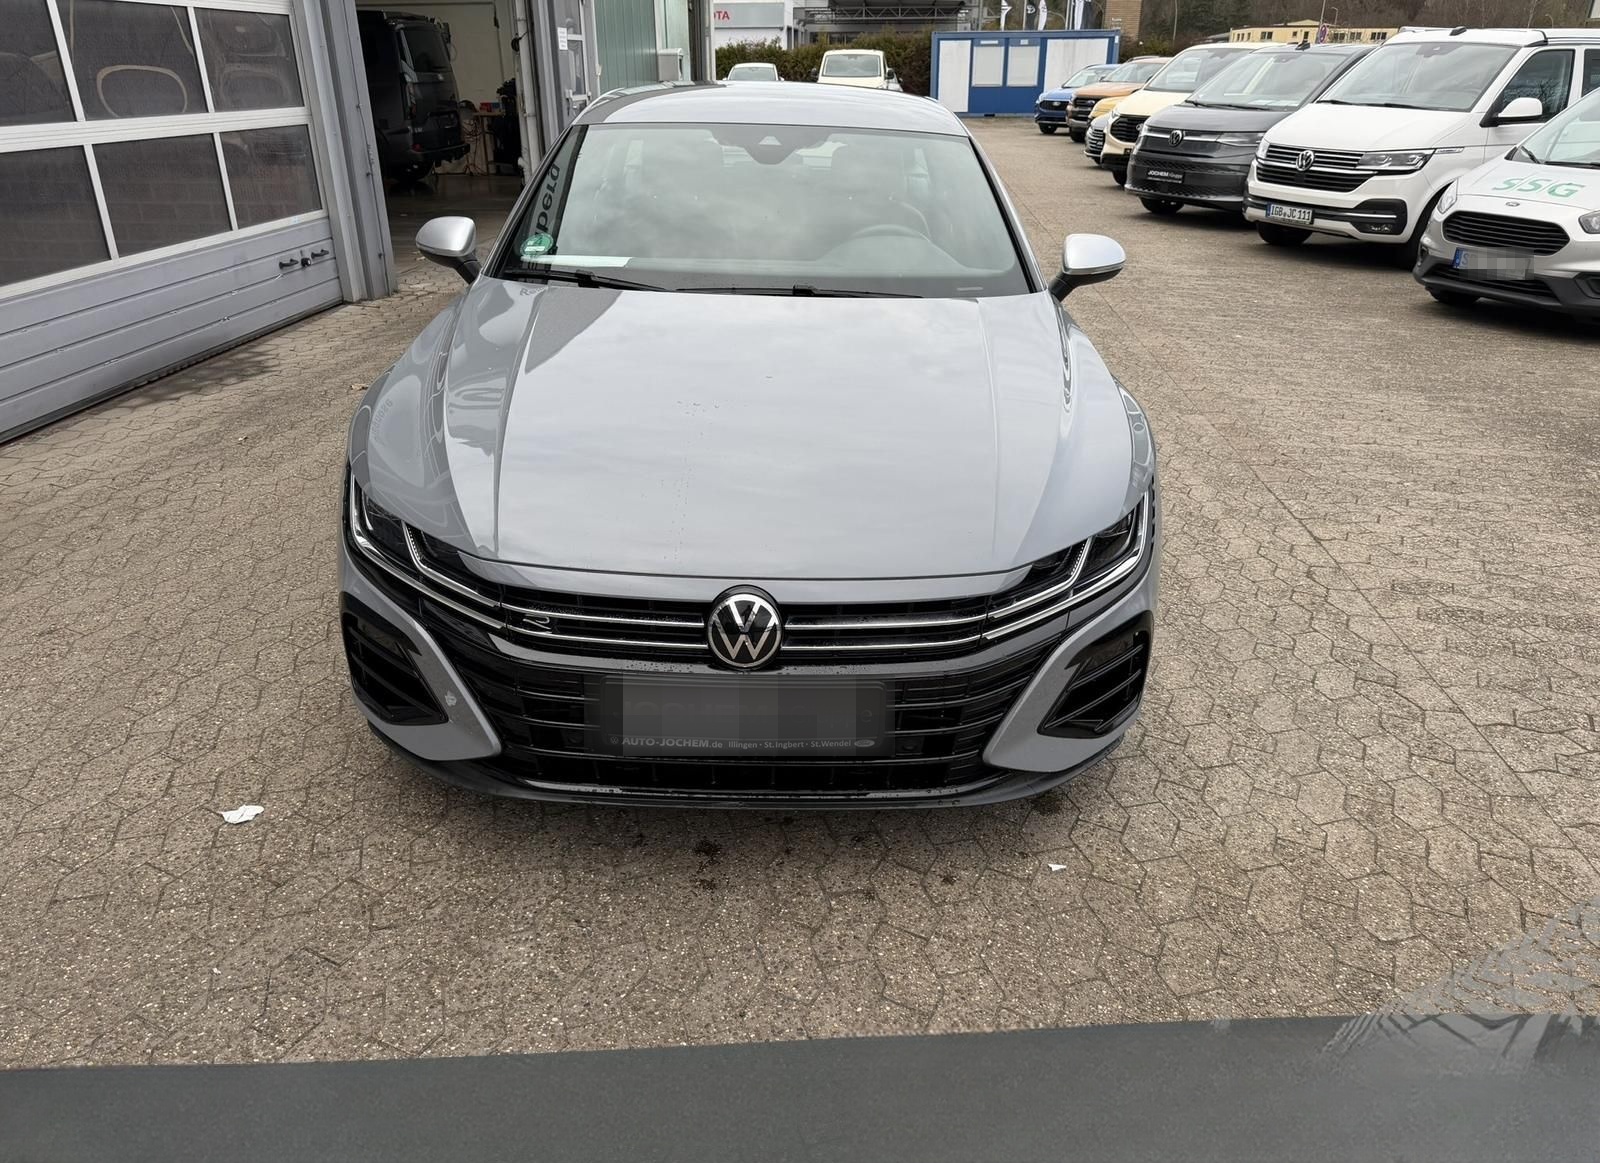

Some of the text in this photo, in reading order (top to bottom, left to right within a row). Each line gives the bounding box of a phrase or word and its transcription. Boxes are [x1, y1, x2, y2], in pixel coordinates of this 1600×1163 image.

[714, 11, 730, 20] TA
[1297, 209, 1311, 221] 111
[729, 740, 758, 750] Illingen
